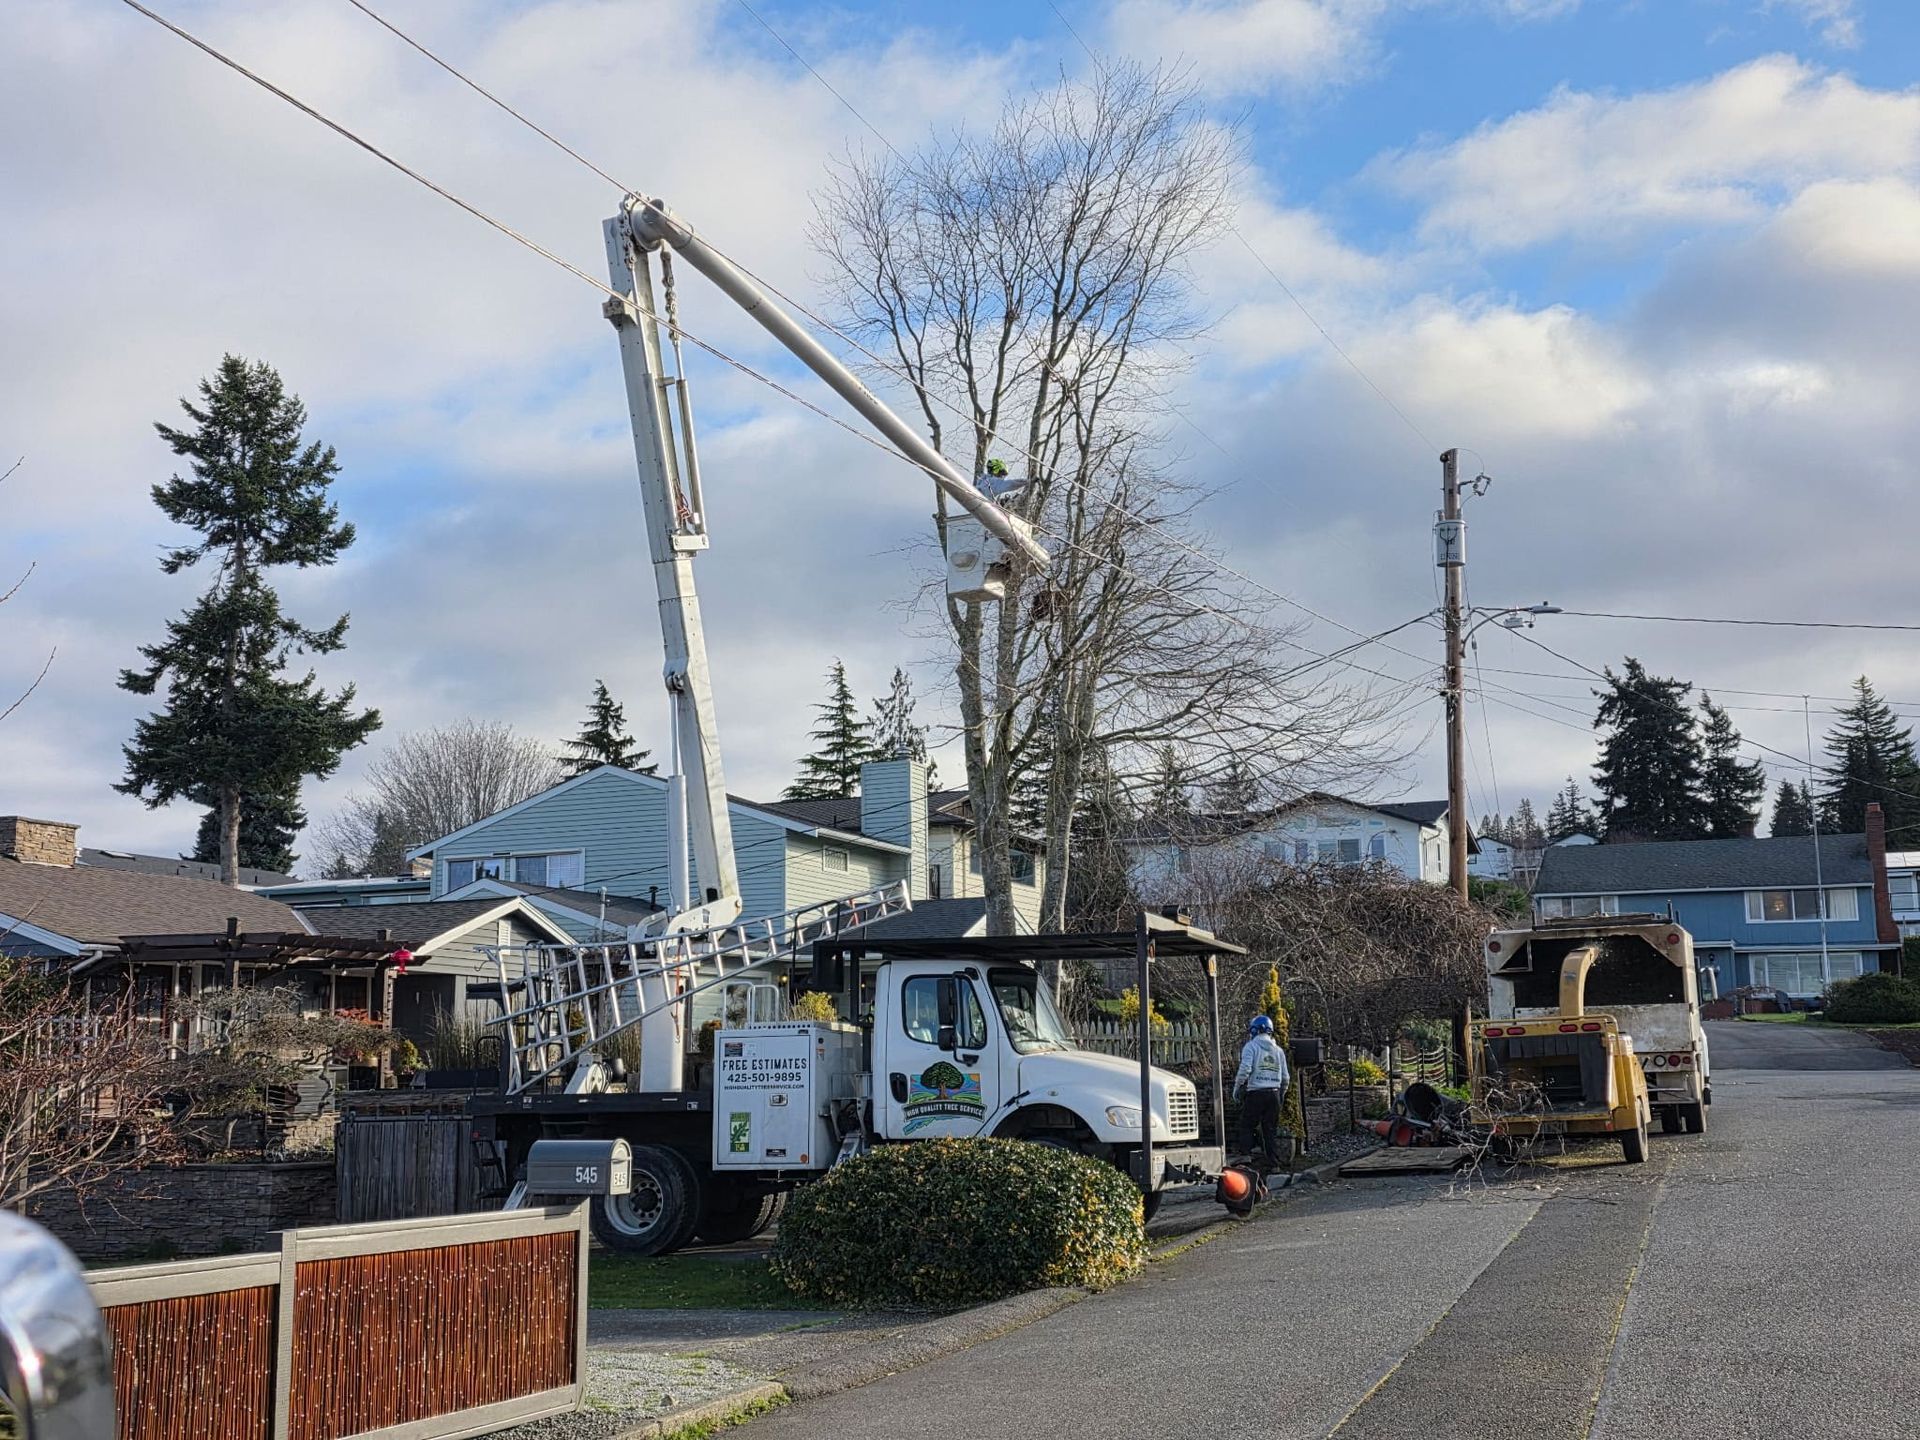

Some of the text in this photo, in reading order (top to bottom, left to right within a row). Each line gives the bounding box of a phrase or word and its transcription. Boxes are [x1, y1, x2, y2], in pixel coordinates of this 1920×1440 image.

[722, 1058, 807, 1071] FREE ESTIMATES
[727, 1072, 802, 1083] 425-501-9895
[906, 1103, 983, 1117] HIGH QUALITY TREE SERVICE
[575, 1166, 598, 1184] 545
[614, 1172, 627, 1185] 545
